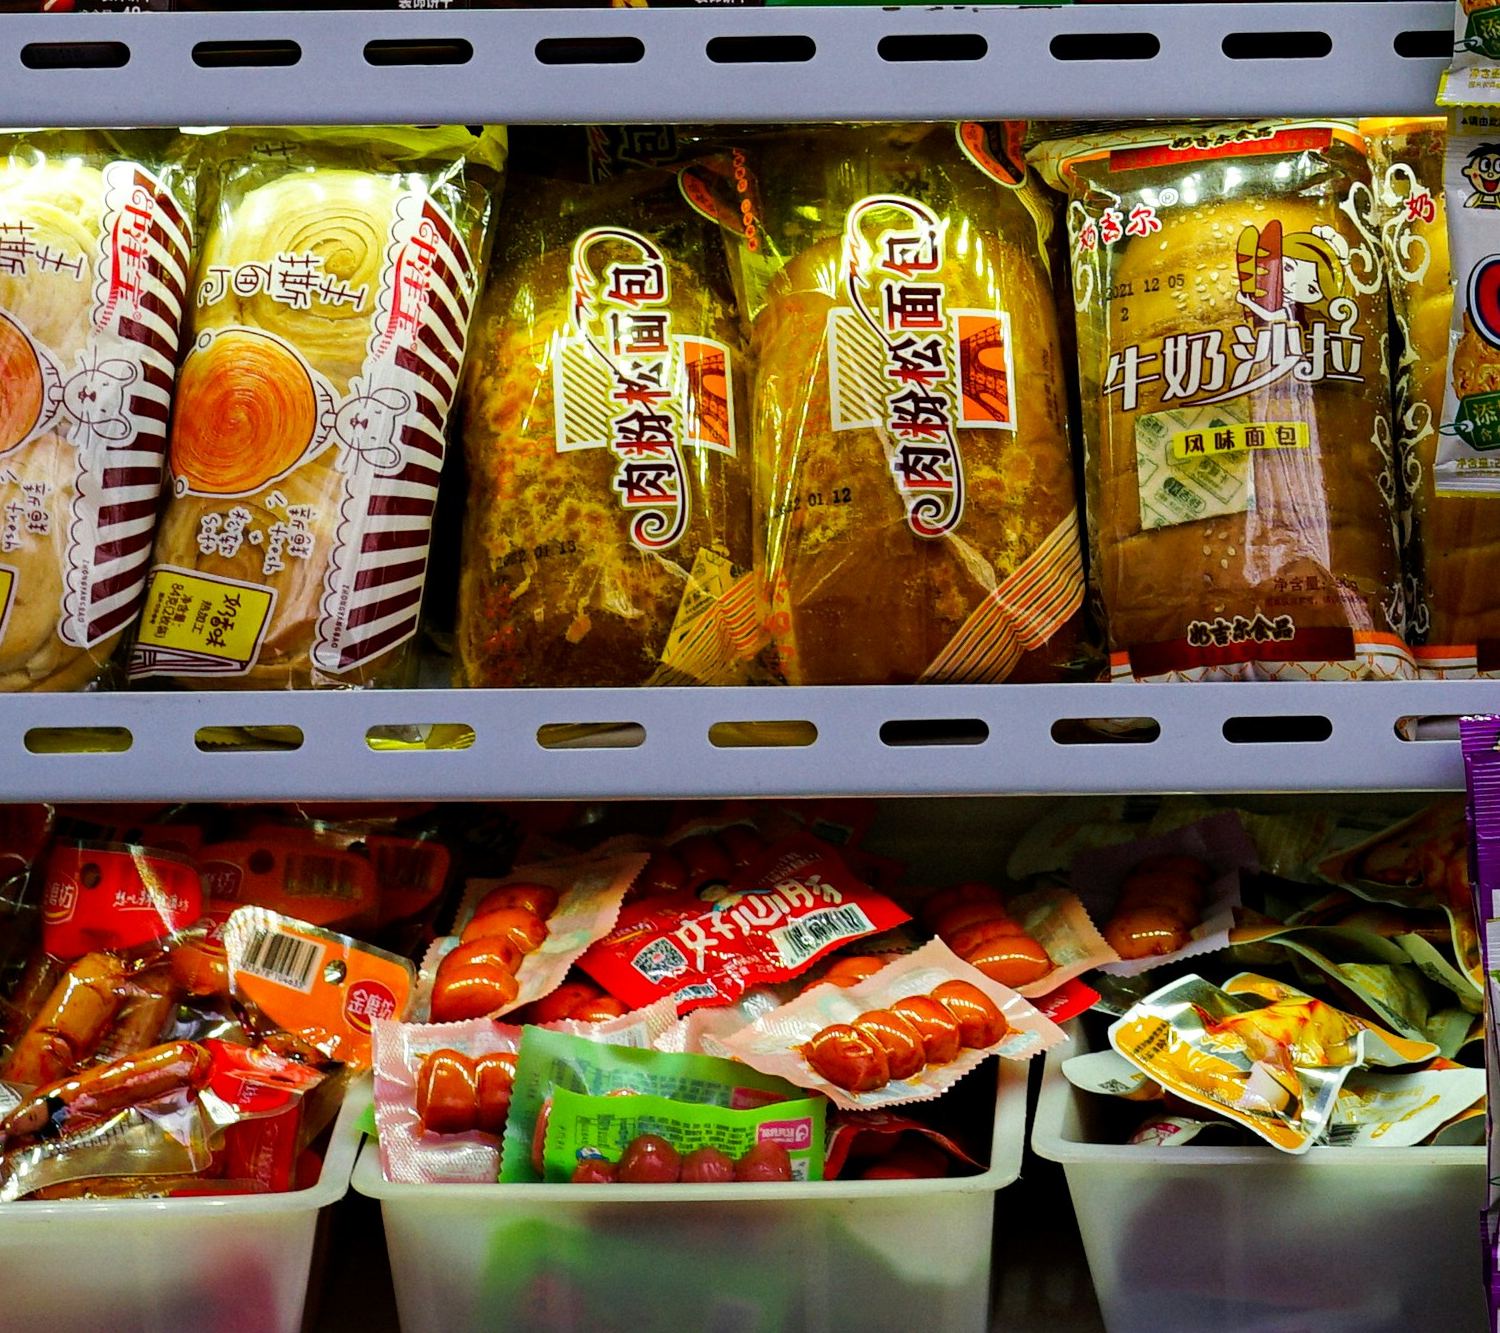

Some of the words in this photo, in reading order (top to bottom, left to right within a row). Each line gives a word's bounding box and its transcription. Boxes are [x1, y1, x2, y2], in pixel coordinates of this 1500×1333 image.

[612, 245, 675, 505] 肉粉松面包
[1104, 322, 1365, 411] 牛奶沙拉
[1183, 424, 1301, 457] 风味面包
